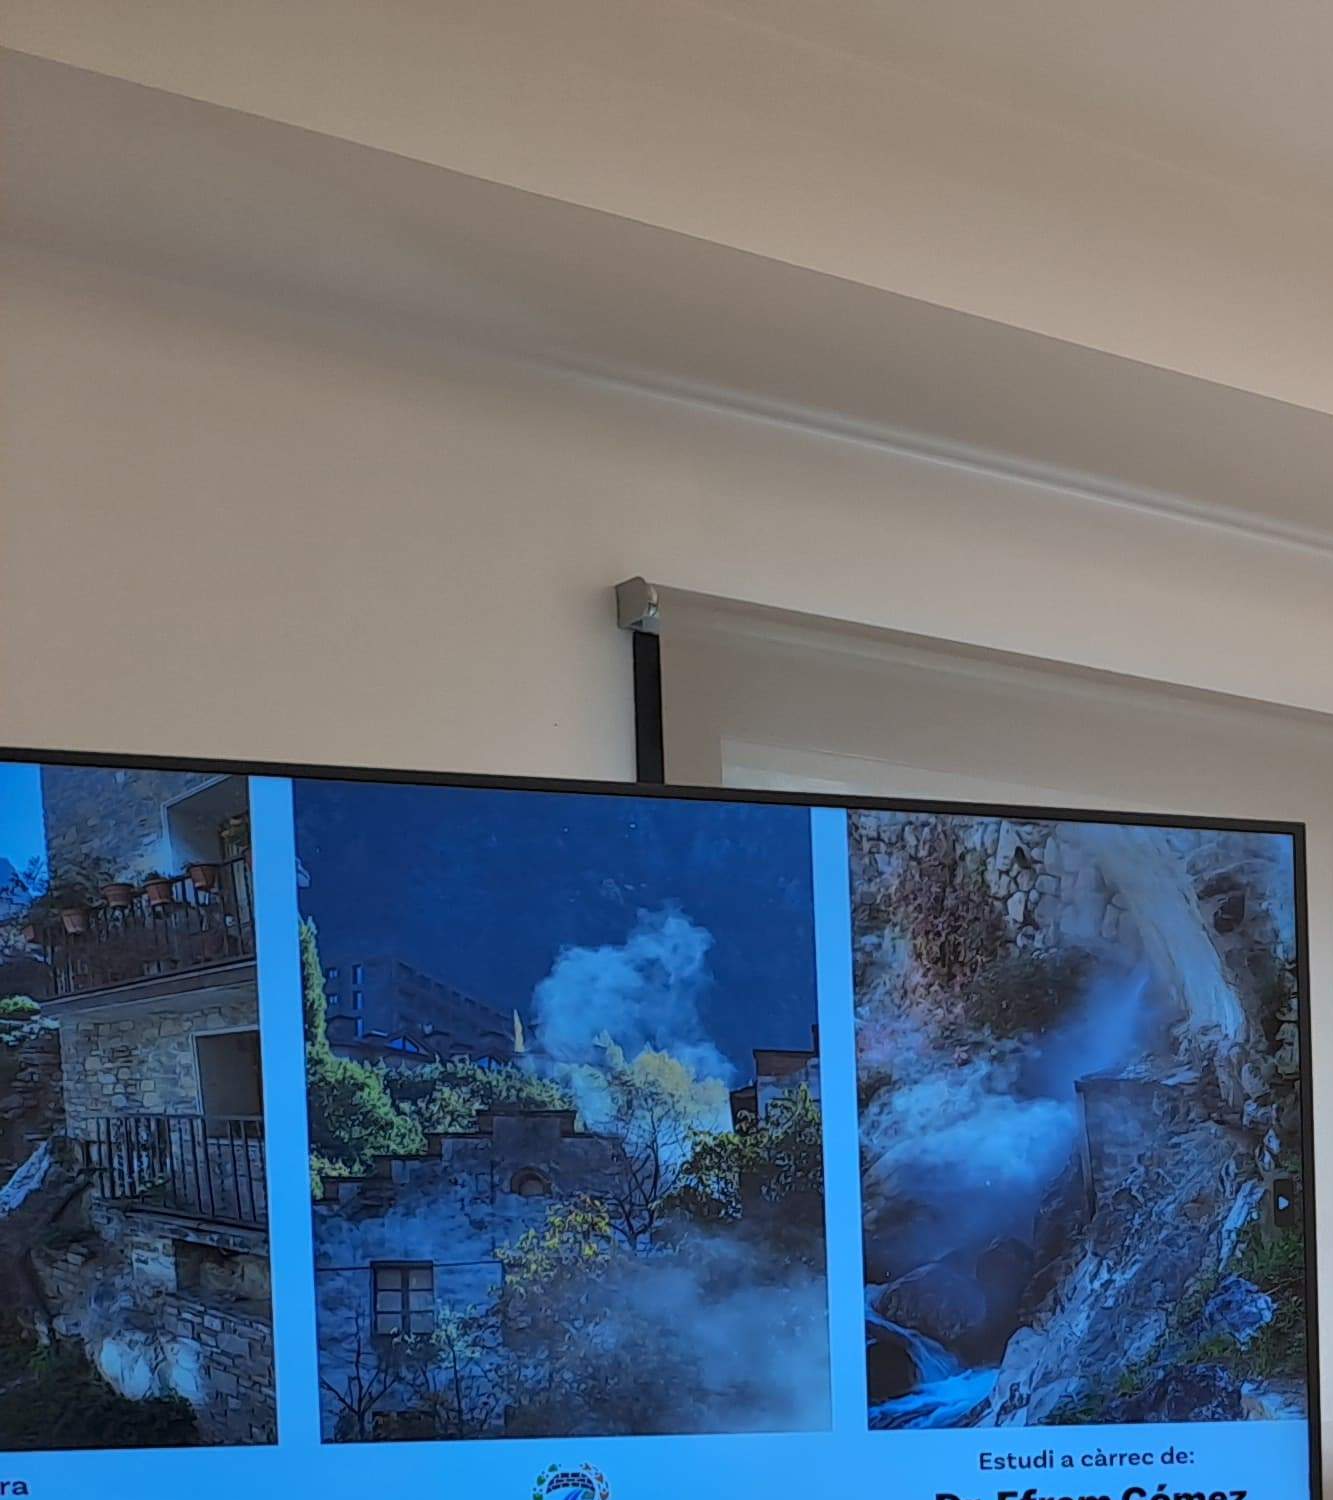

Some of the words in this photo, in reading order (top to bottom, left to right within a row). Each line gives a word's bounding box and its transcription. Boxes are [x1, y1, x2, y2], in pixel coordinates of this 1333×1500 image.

[979, 1450, 1055, 1471] Estudi
[1061, 1455, 1075, 1469] a
[1081, 1448, 1154, 1468] càrrec
[1161, 1447, 1195, 1465] de:
